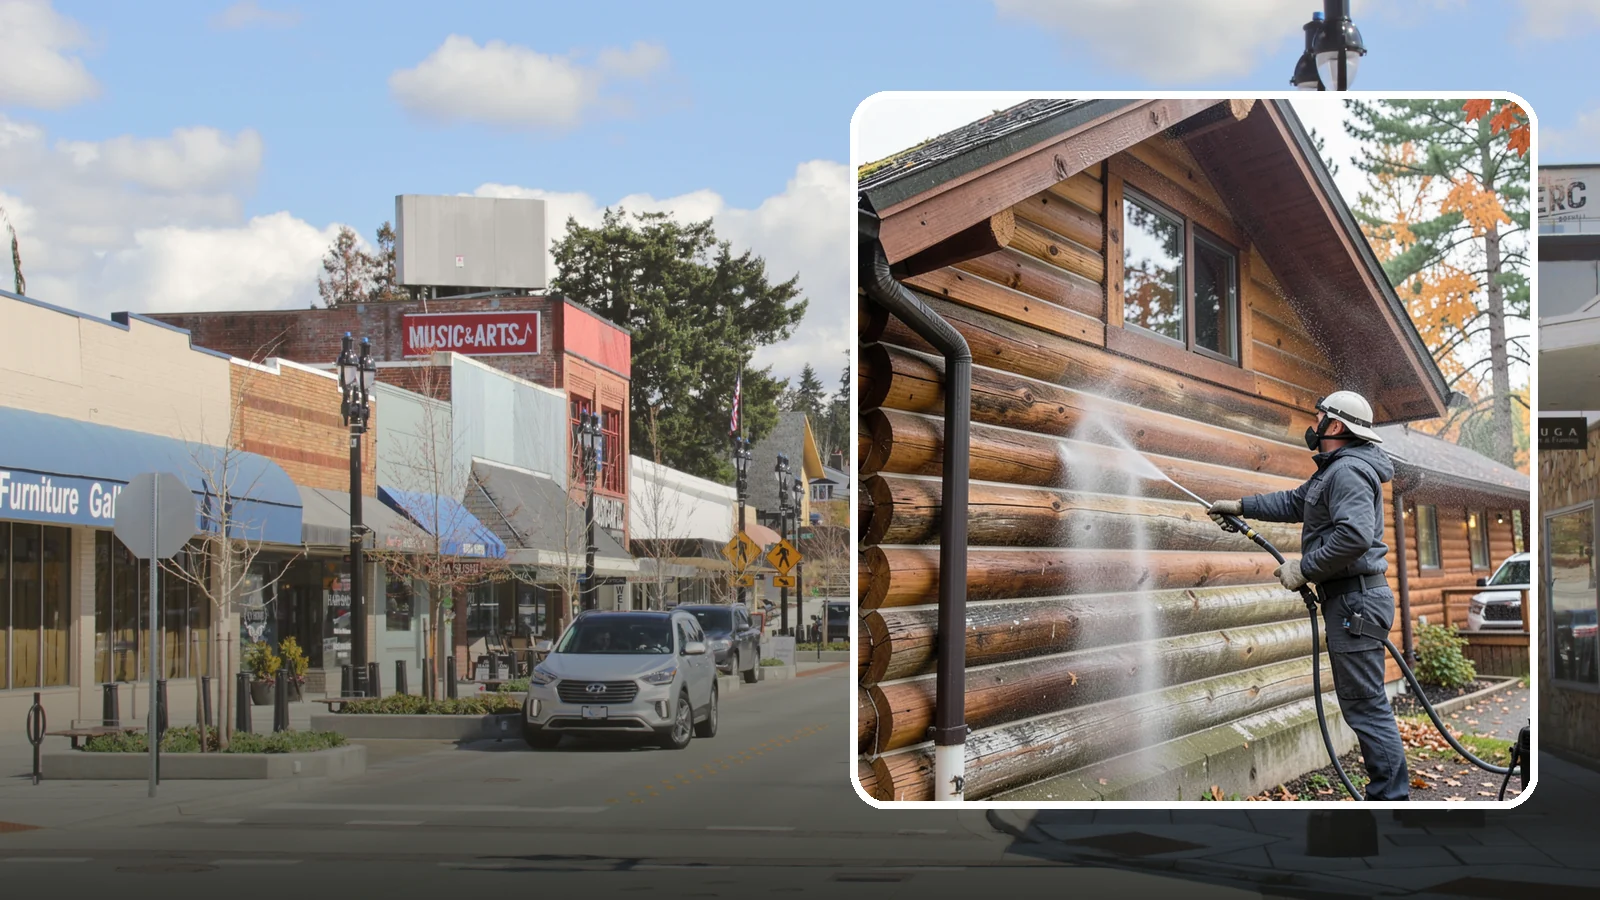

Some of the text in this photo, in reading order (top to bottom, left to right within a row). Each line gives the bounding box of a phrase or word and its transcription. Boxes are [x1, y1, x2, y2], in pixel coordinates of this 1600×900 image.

[0, 471, 122, 519] Furniture Gal
[453, 563, 479, 574] SUSHI
